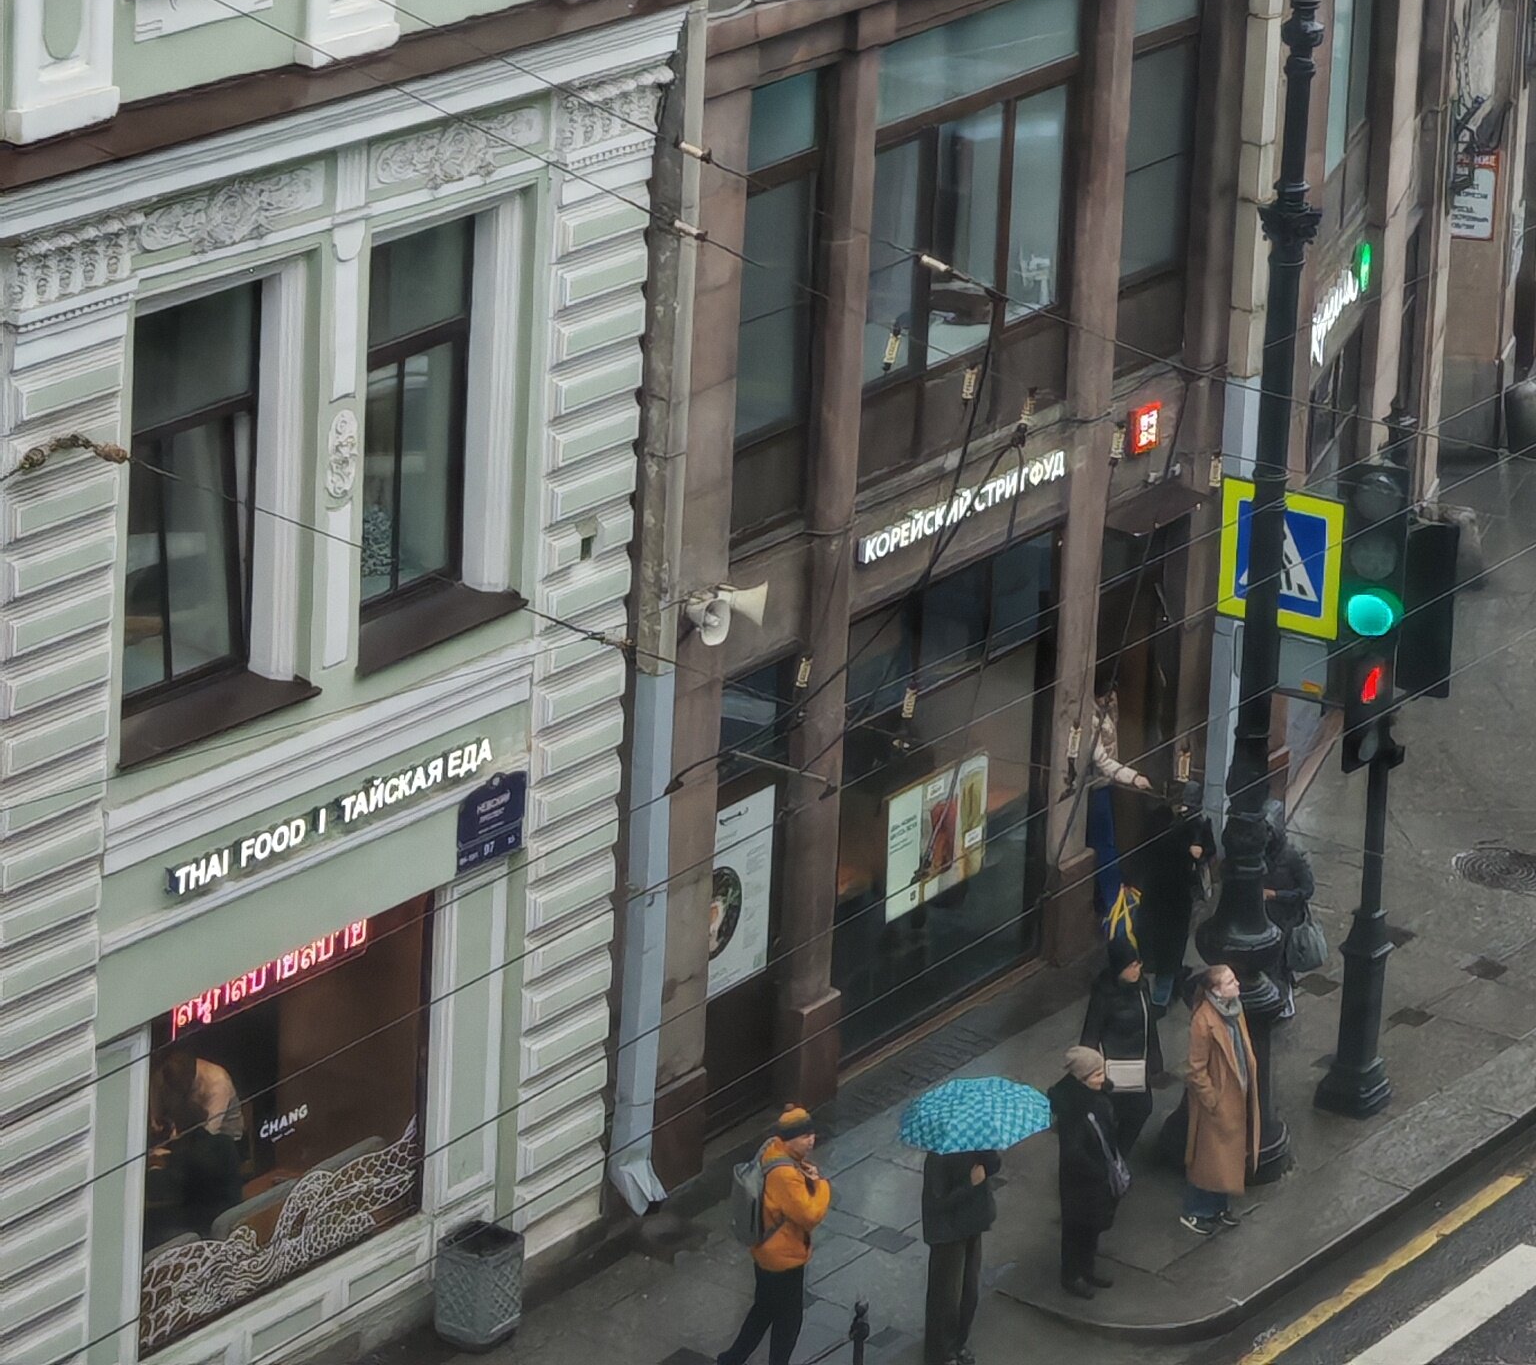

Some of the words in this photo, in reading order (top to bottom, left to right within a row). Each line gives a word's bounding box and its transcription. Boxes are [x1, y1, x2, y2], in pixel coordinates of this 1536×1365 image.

[1029, 449, 1065, 487] ФУД
[175, 849, 230, 894] THAI
[240, 819, 306, 868] FOOD
[341, 758, 443, 822] ТАЙСКАЯ
[448, 738, 494, 777] ЕДА
[260, 1103, 308, 1138] CHANG
